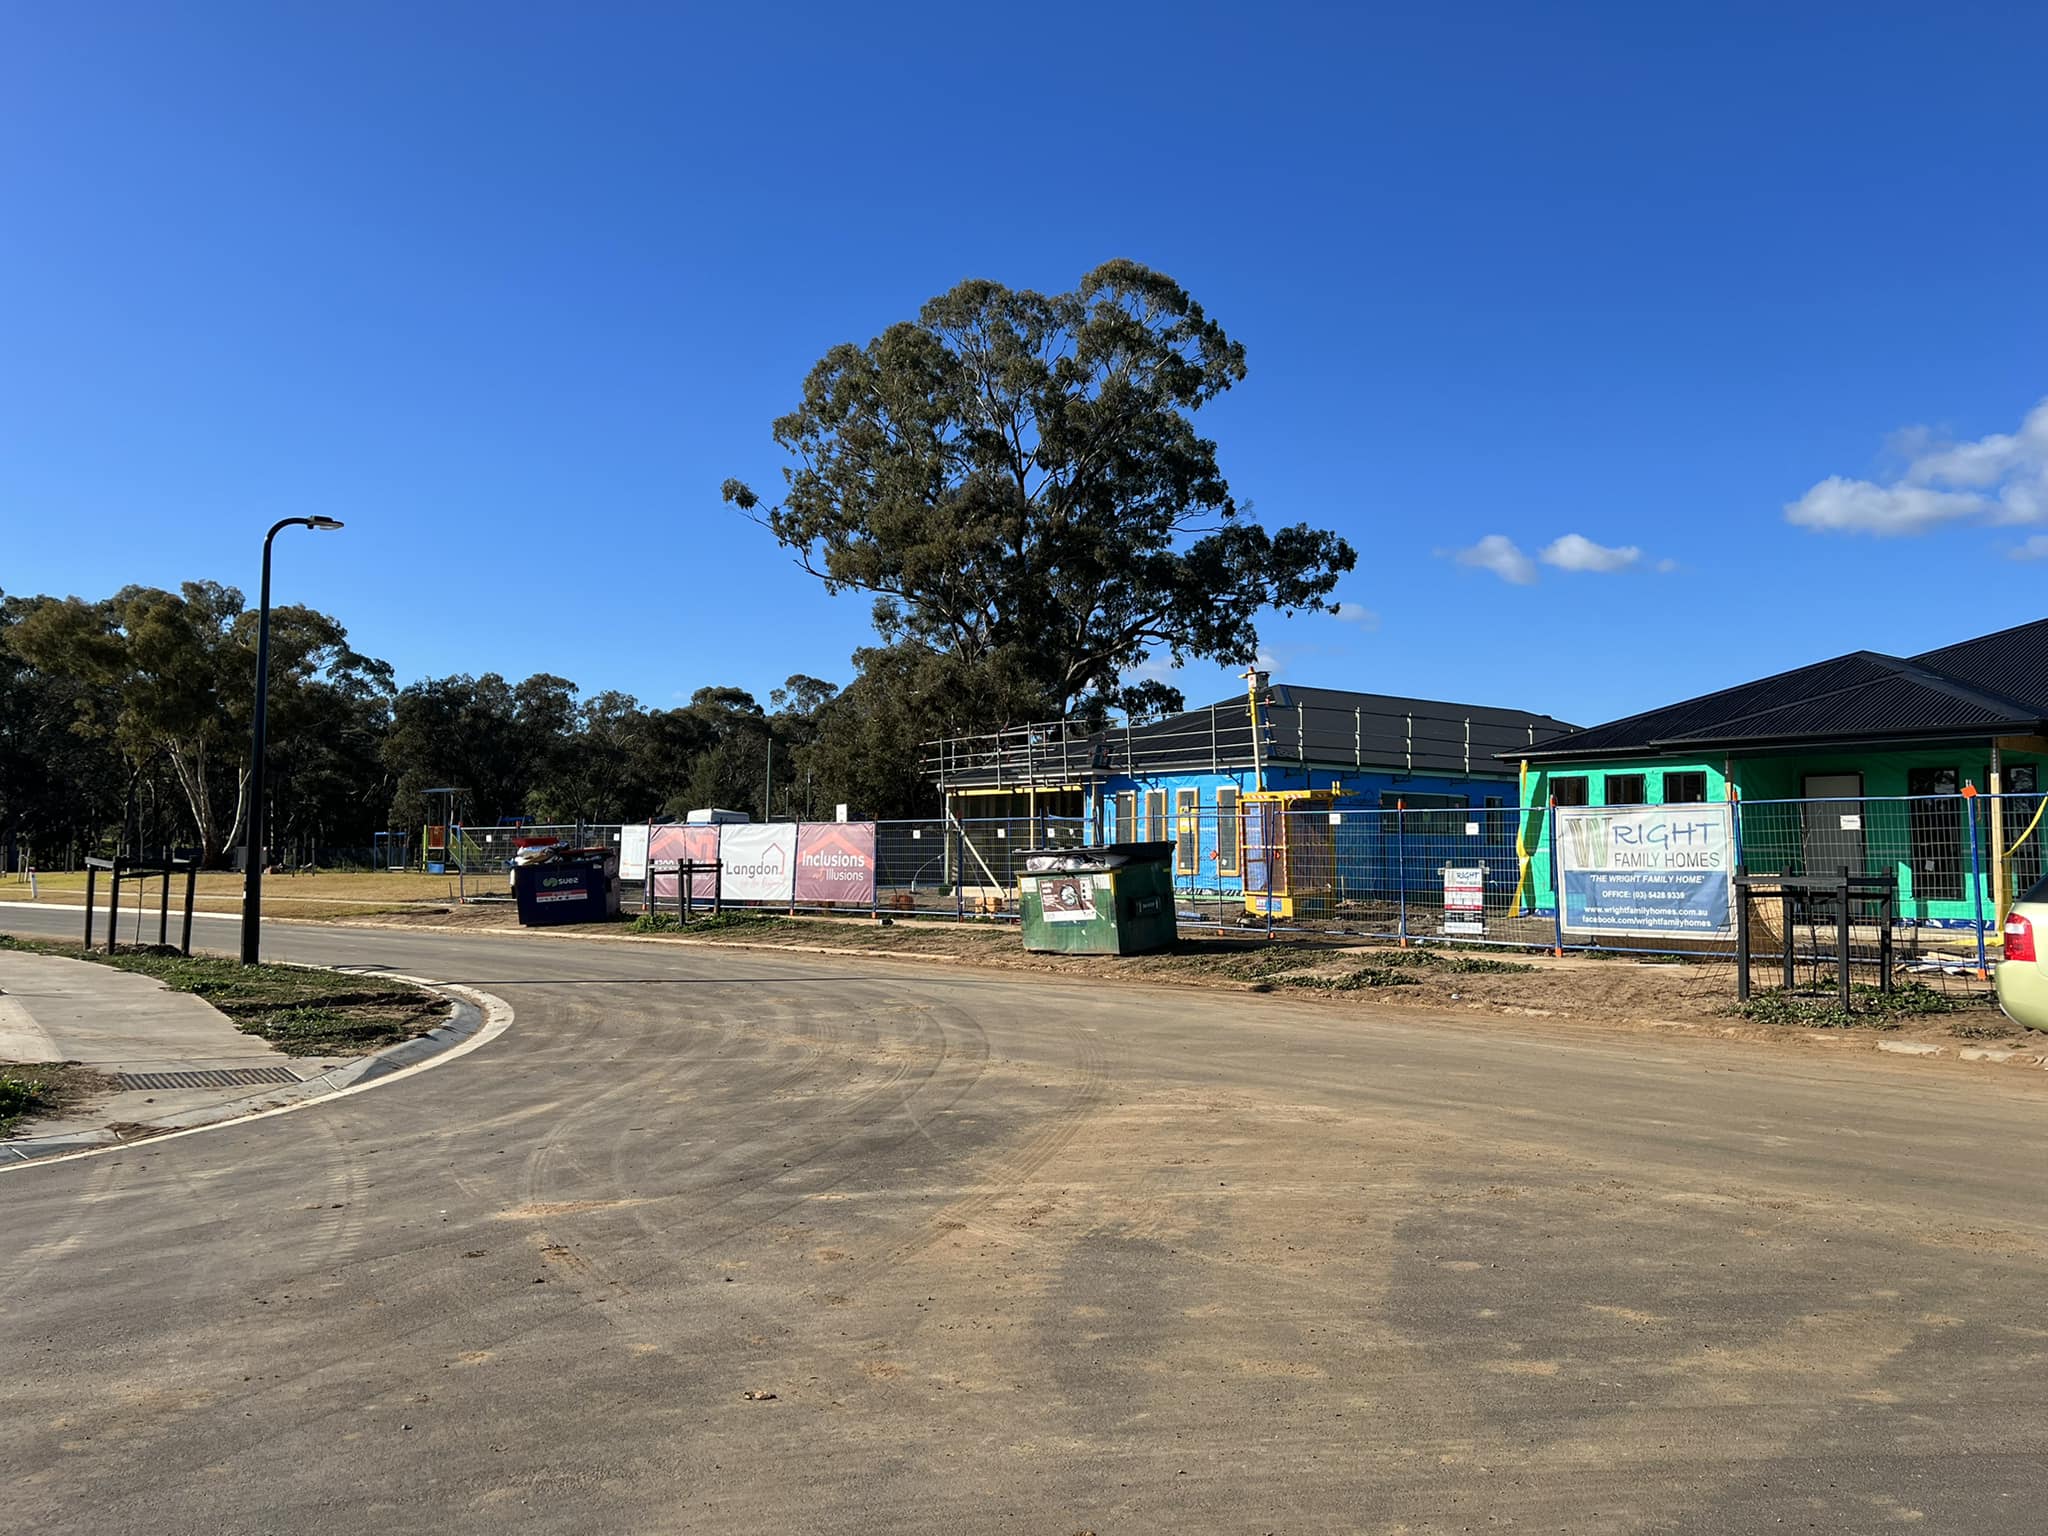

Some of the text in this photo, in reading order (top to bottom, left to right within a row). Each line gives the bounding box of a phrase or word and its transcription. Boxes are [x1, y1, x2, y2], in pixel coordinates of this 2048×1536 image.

[802, 850, 865, 867] Inclusions
[1614, 852, 1720, 867] FAMILY HOMES
[726, 860, 779, 879] Langdon
[826, 869, 864, 881] Illusions
[558, 877, 579, 885] suez
[1609, 875, 1641, 883] WRIGHT
[1643, 875, 1674, 884] FAMILY
[1584, 906, 1708, 917] www.wrightfamilyhomes.com.au
[1582, 915, 1712, 927] facebook.com/wrightfamilyhomes
